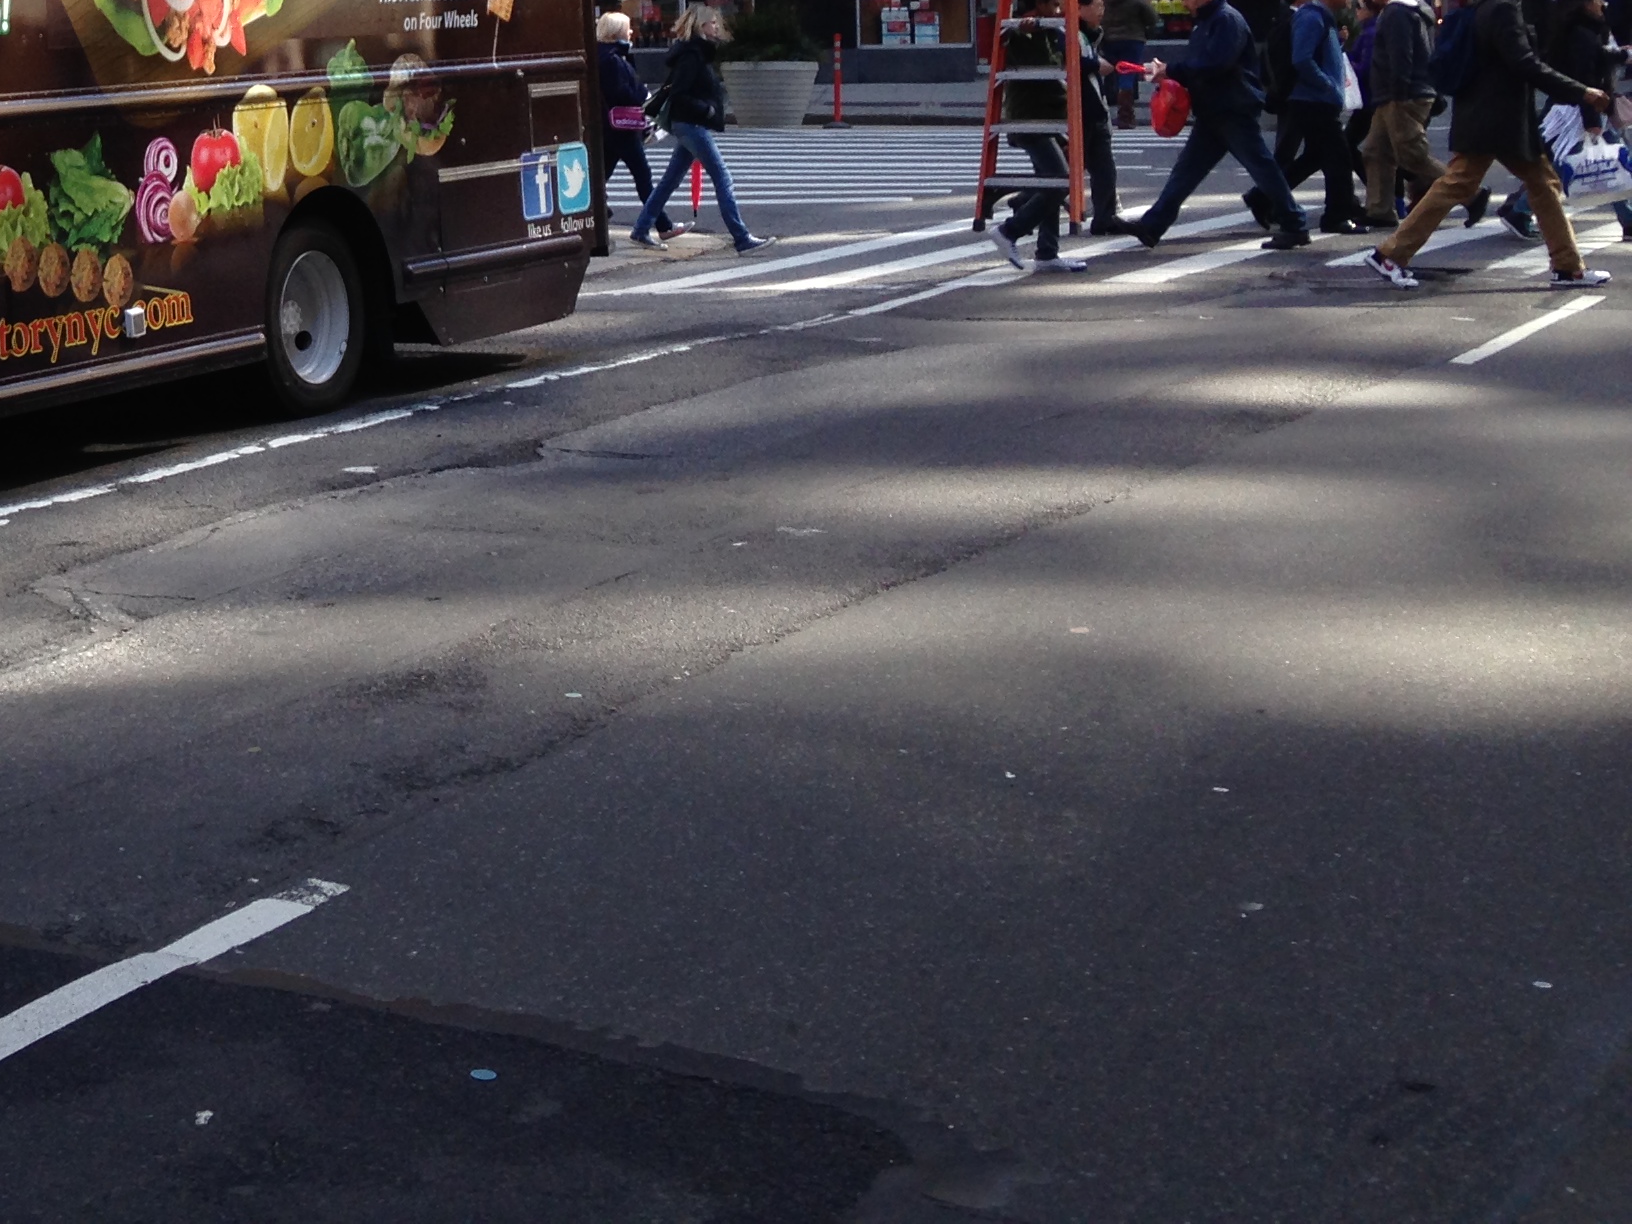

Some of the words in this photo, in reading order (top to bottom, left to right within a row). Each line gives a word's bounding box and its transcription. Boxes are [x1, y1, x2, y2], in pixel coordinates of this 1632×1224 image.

[404, 17, 417, 31] on
[420, 13, 442, 30] Four
[444, 11, 478, 27] Wheels
[528, 223, 542, 237] like
[542, 224, 552, 236] us
[560, 217, 584, 233] follow
[585, 216, 595, 229] us
